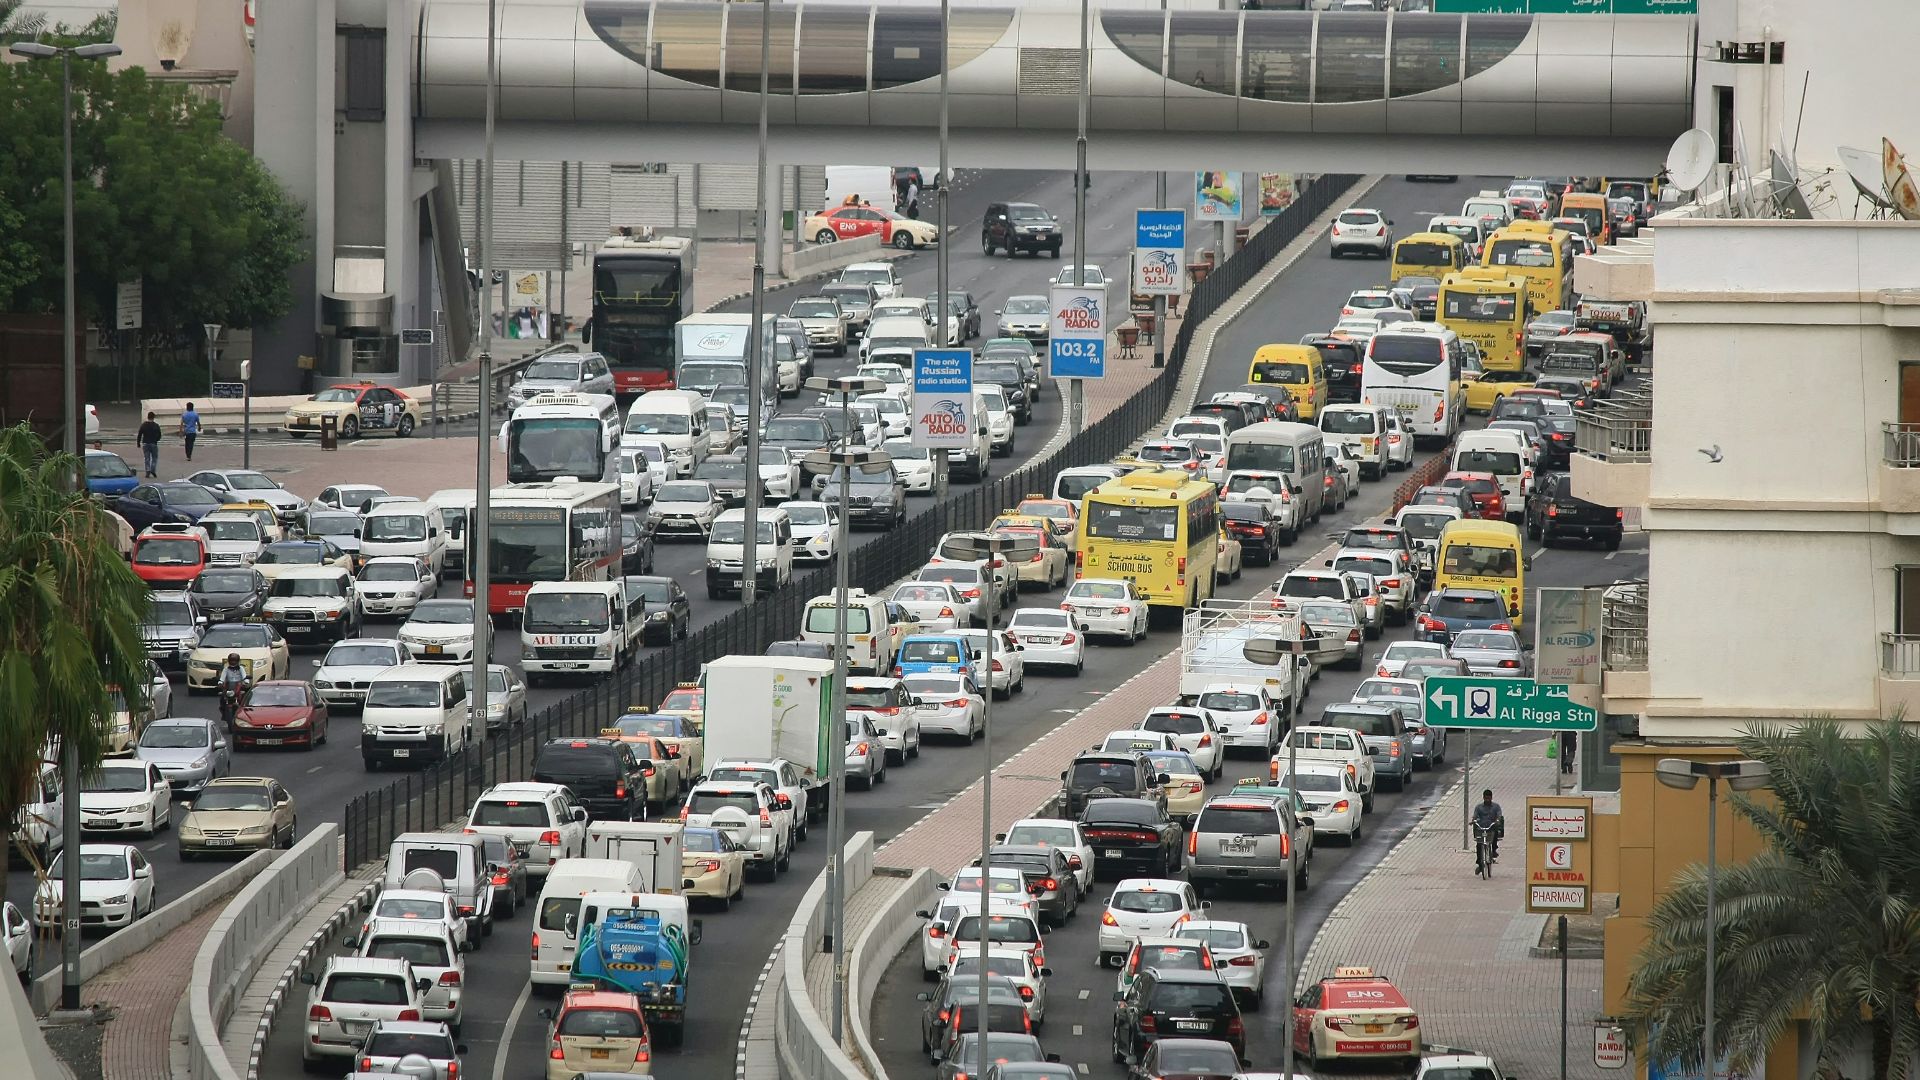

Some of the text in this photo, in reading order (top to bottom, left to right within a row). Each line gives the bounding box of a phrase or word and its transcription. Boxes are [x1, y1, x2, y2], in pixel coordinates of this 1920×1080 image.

[840, 222, 857, 230] ENG
[1057, 309, 1088, 319] AUTO
[1065, 319, 1100, 329] RADIO
[1054, 342, 1097, 357] 103.2
[925, 358, 960, 367] The only
[921, 366, 961, 375] Russian
[917, 377, 967, 385] radio station
[919, 413, 953, 424] AUTO
[928, 424, 967, 434] RADIO
[1108, 552, 1152, 562] حافلة مدرسية
[1107, 561, 1153, 573] SCHOOL BUS
[1544, 637, 1556, 646] AL
[1506, 683, 1569, 700] طة الرقة
[1500, 707, 1593, 723] Al Rigga Stn
[1533, 811, 1585, 824] صيدلية
[1534, 824, 1583, 835] الروضة
[1533, 872, 1585, 881] AL RAWDA
[1532, 891, 1583, 903] PHARMACY
[68, 920, 78, 929] 64
[1346, 990, 1385, 998] ENG
[1606, 1033, 1615, 1041] AL
